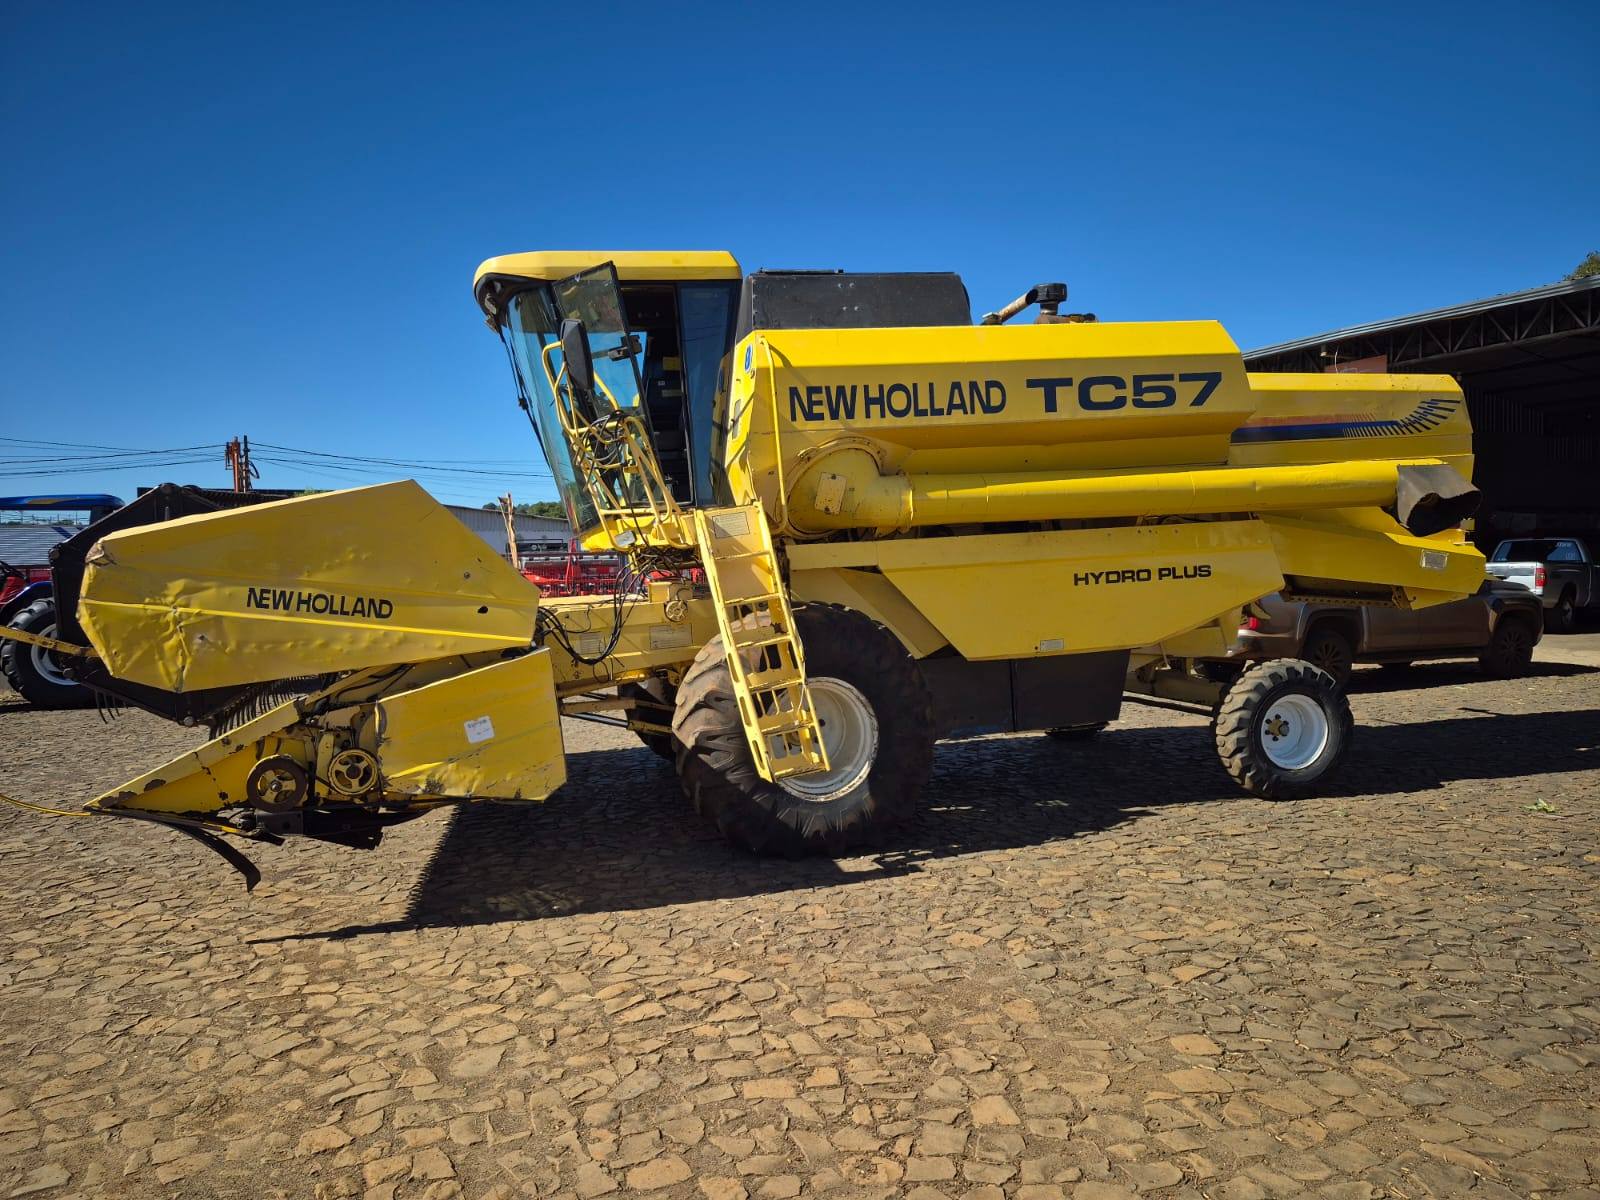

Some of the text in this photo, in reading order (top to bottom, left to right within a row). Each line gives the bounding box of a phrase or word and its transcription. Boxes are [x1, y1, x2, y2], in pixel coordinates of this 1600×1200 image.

[789, 372, 1222, 421] NEW HOLLAND TC57
[1074, 565, 1212, 586] HYDRO PLUS
[246, 587, 394, 619] NEW HOLLAND
